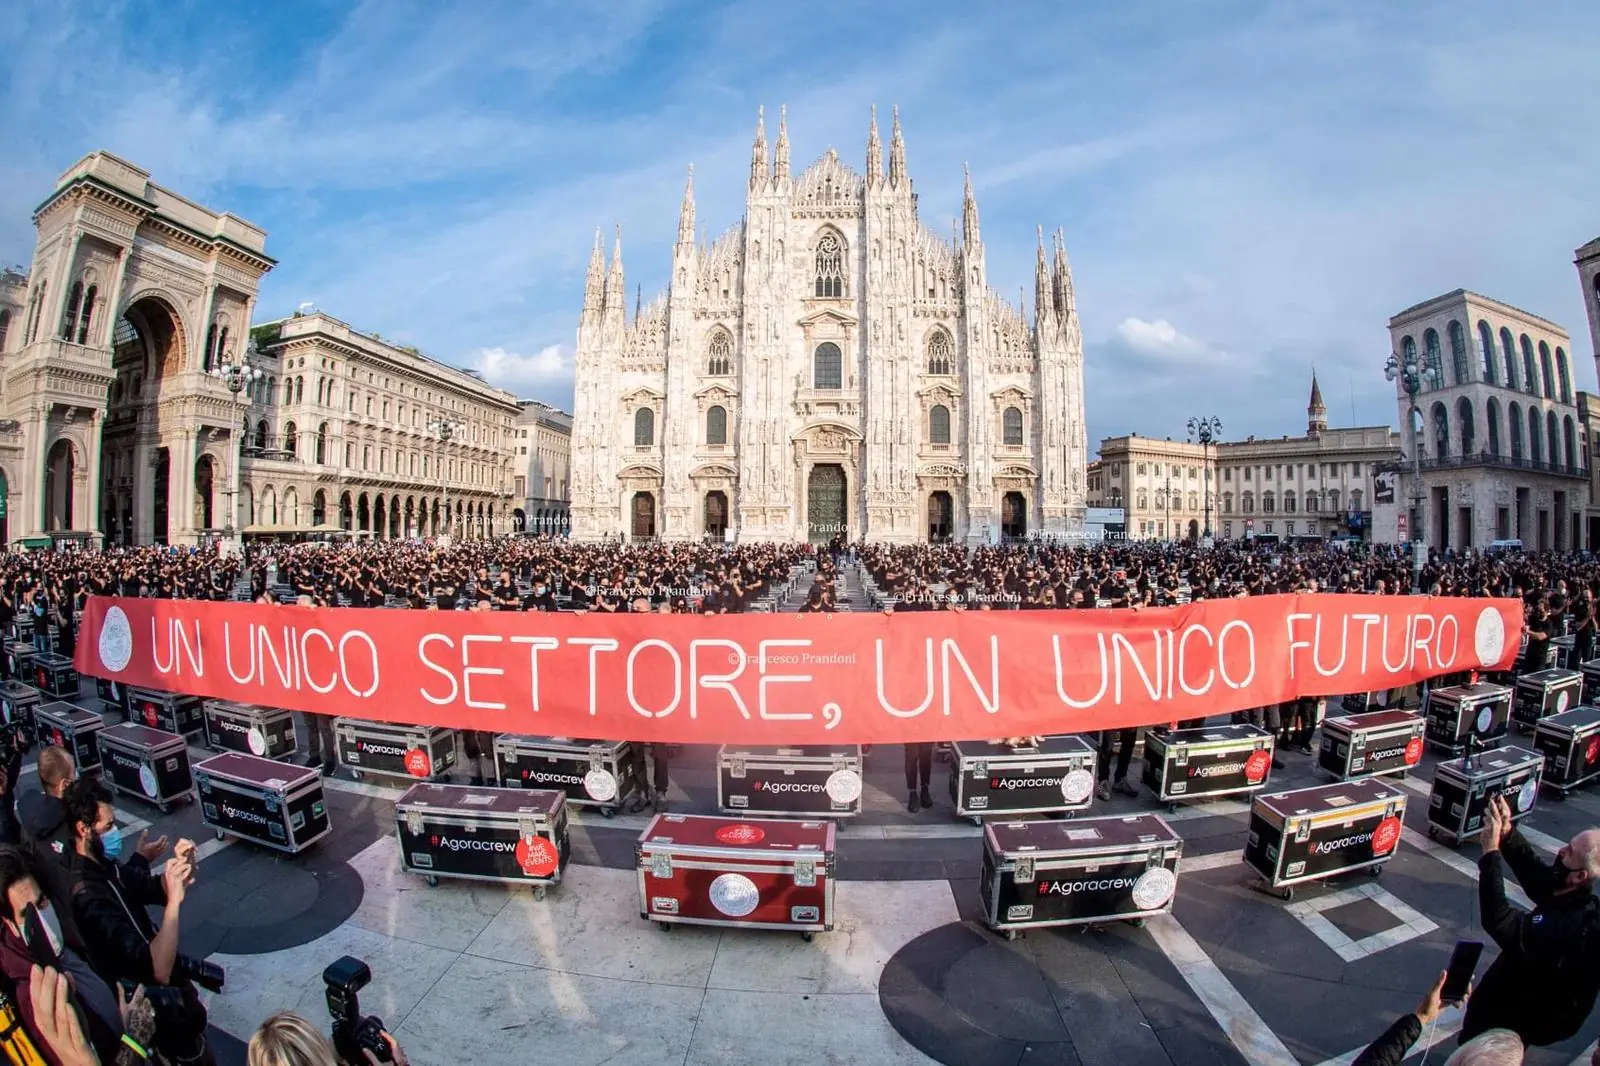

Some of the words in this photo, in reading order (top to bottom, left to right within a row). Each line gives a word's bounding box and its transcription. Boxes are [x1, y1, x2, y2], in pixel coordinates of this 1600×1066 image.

[151, 615, 203, 677] UN
[224, 621, 379, 697] UNICO
[418, 632, 842, 730] SETTORE,
[875, 634, 999, 718] UN
[1052, 620, 1255, 709] UNICO
[1286, 613, 1459, 680] FUTURO
[1188, 761, 1247, 778] #Agoracrew
[990, 776, 1063, 790] #Agoracrew
[430, 834, 516, 852] #Agoracrew
[1308, 831, 1374, 854] #Agoracrew
[1038, 876, 1138, 895] #Agoracrew
